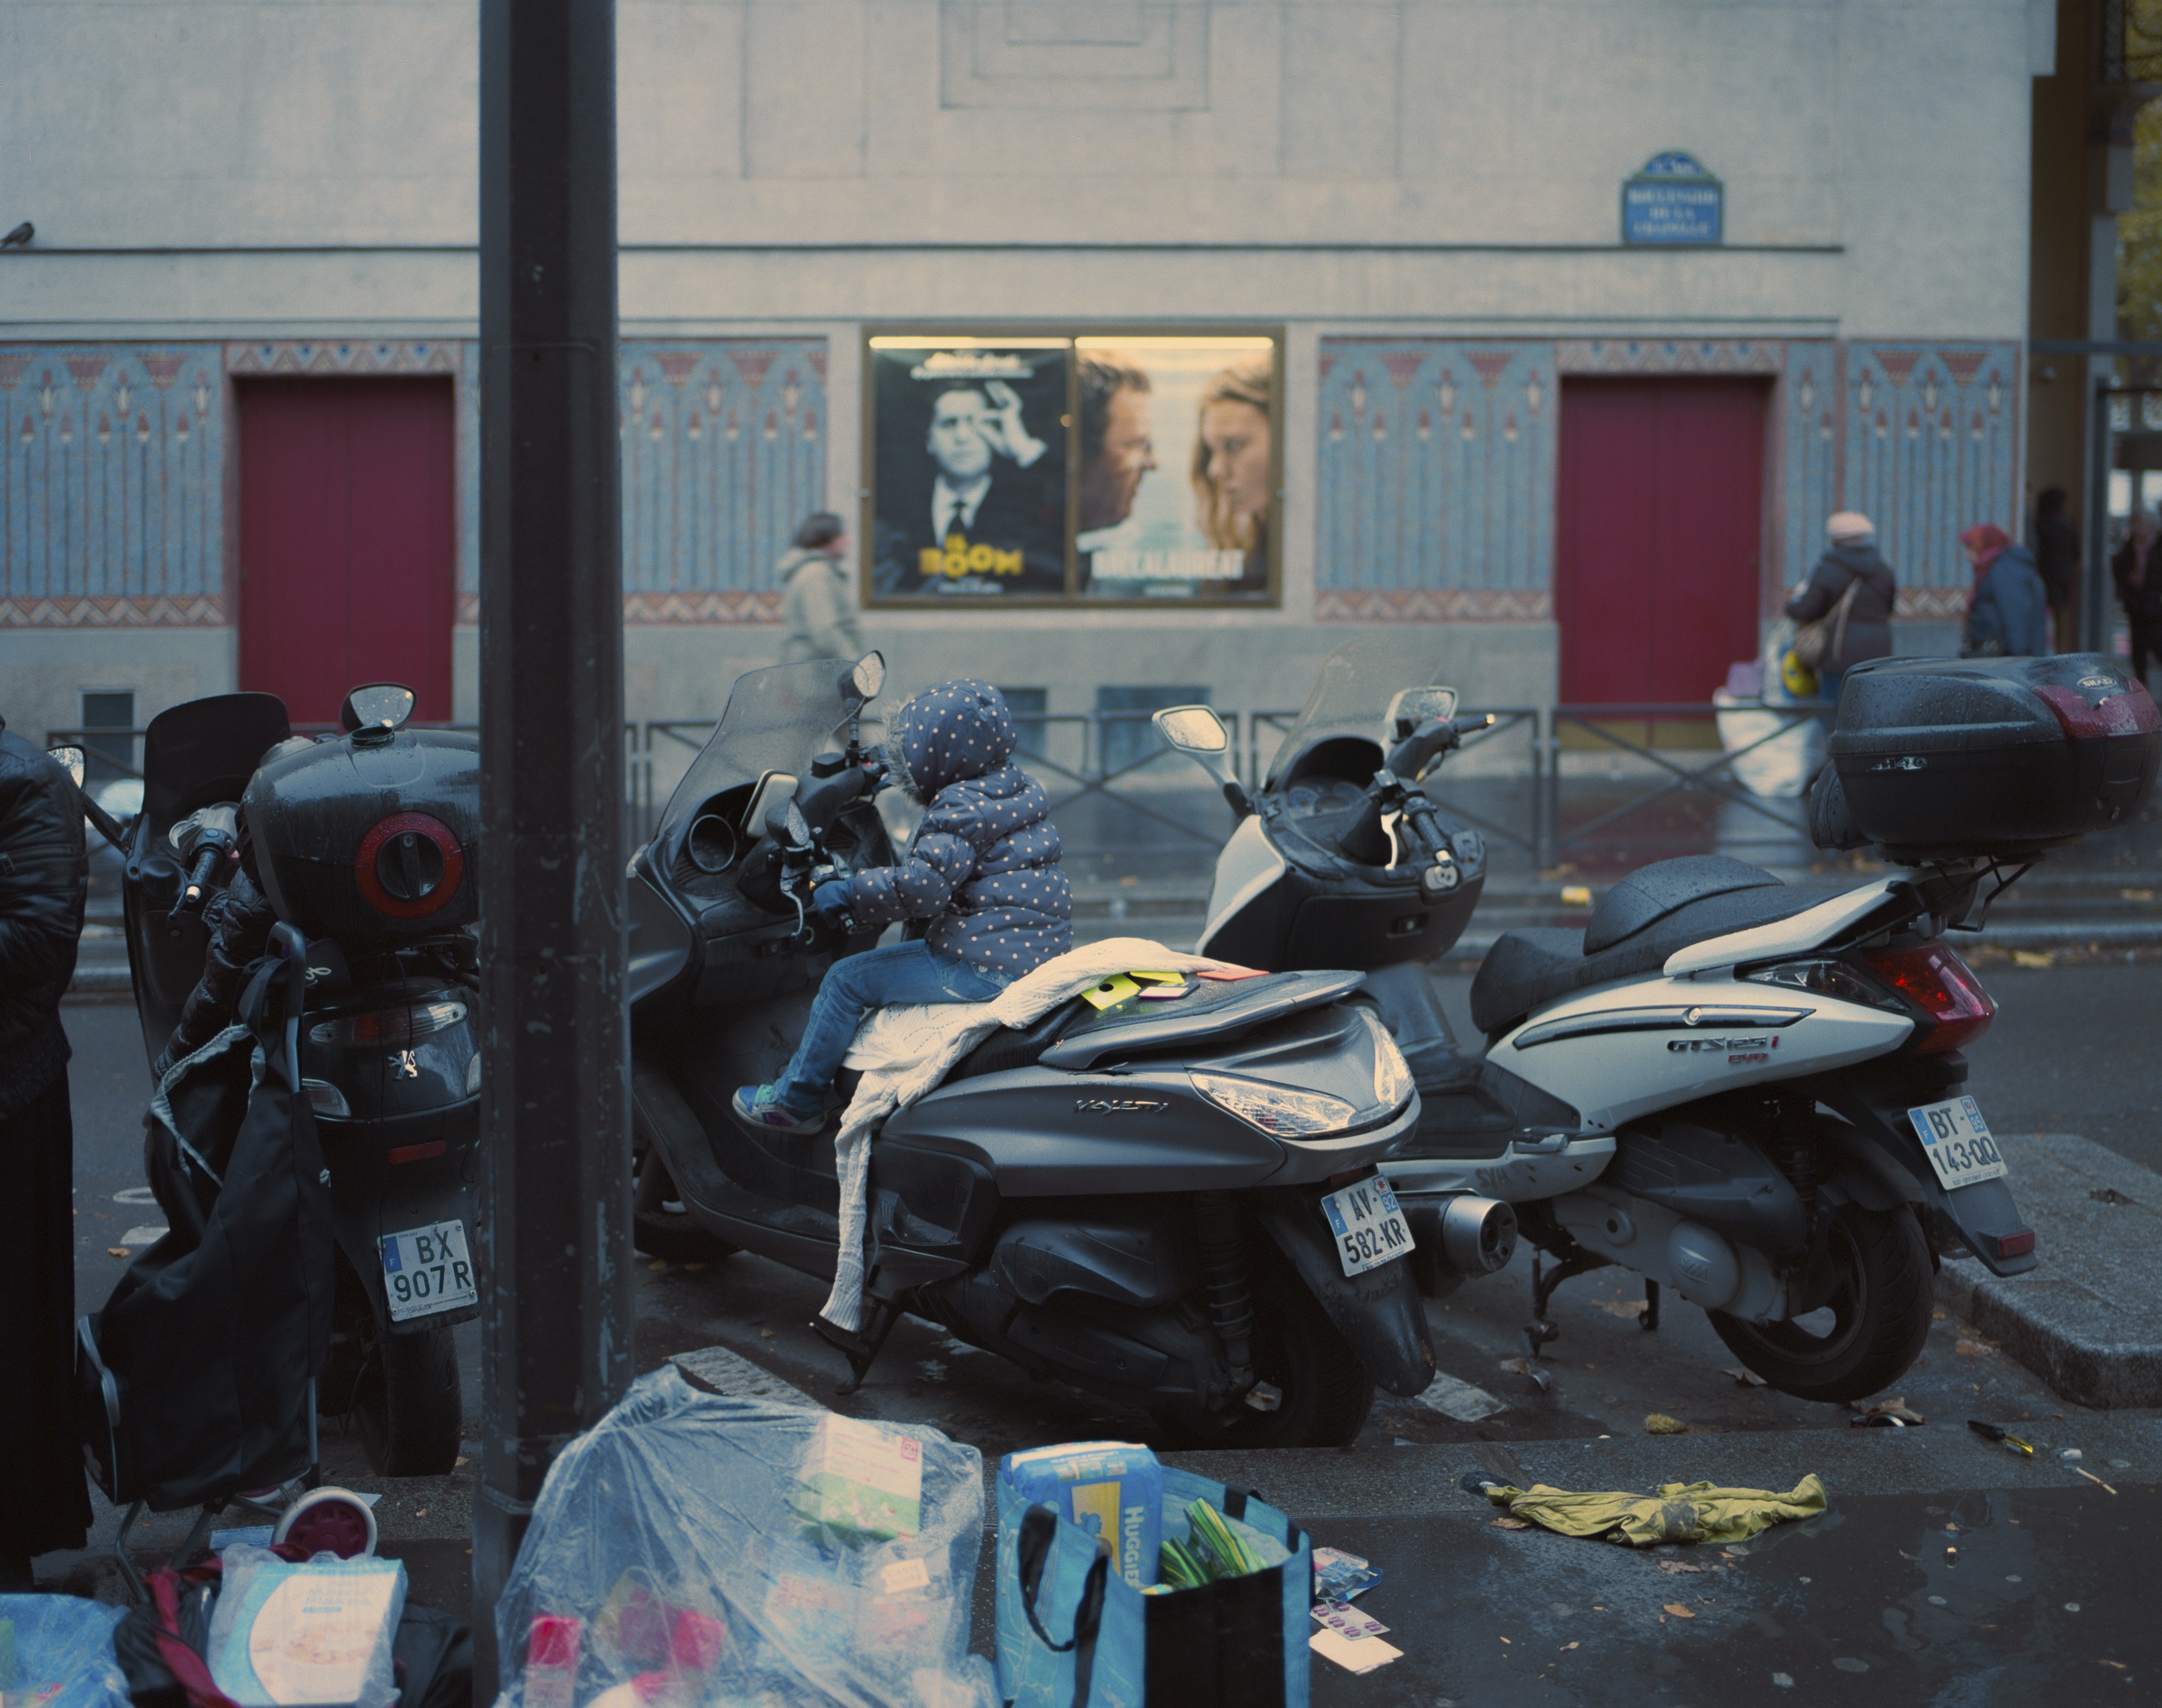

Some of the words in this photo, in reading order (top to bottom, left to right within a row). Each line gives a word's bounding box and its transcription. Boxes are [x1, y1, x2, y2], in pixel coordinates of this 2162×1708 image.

[1728, 1052, 1767, 1064] EVO
[1970, 1115, 1984, 1131] 95
[1933, 1136, 2002, 1175] 143-QQ
[1382, 1195, 1396, 1211] 92
[415, 1231, 454, 1265] BX
[1343, 1218, 1406, 1264] 582-KR
